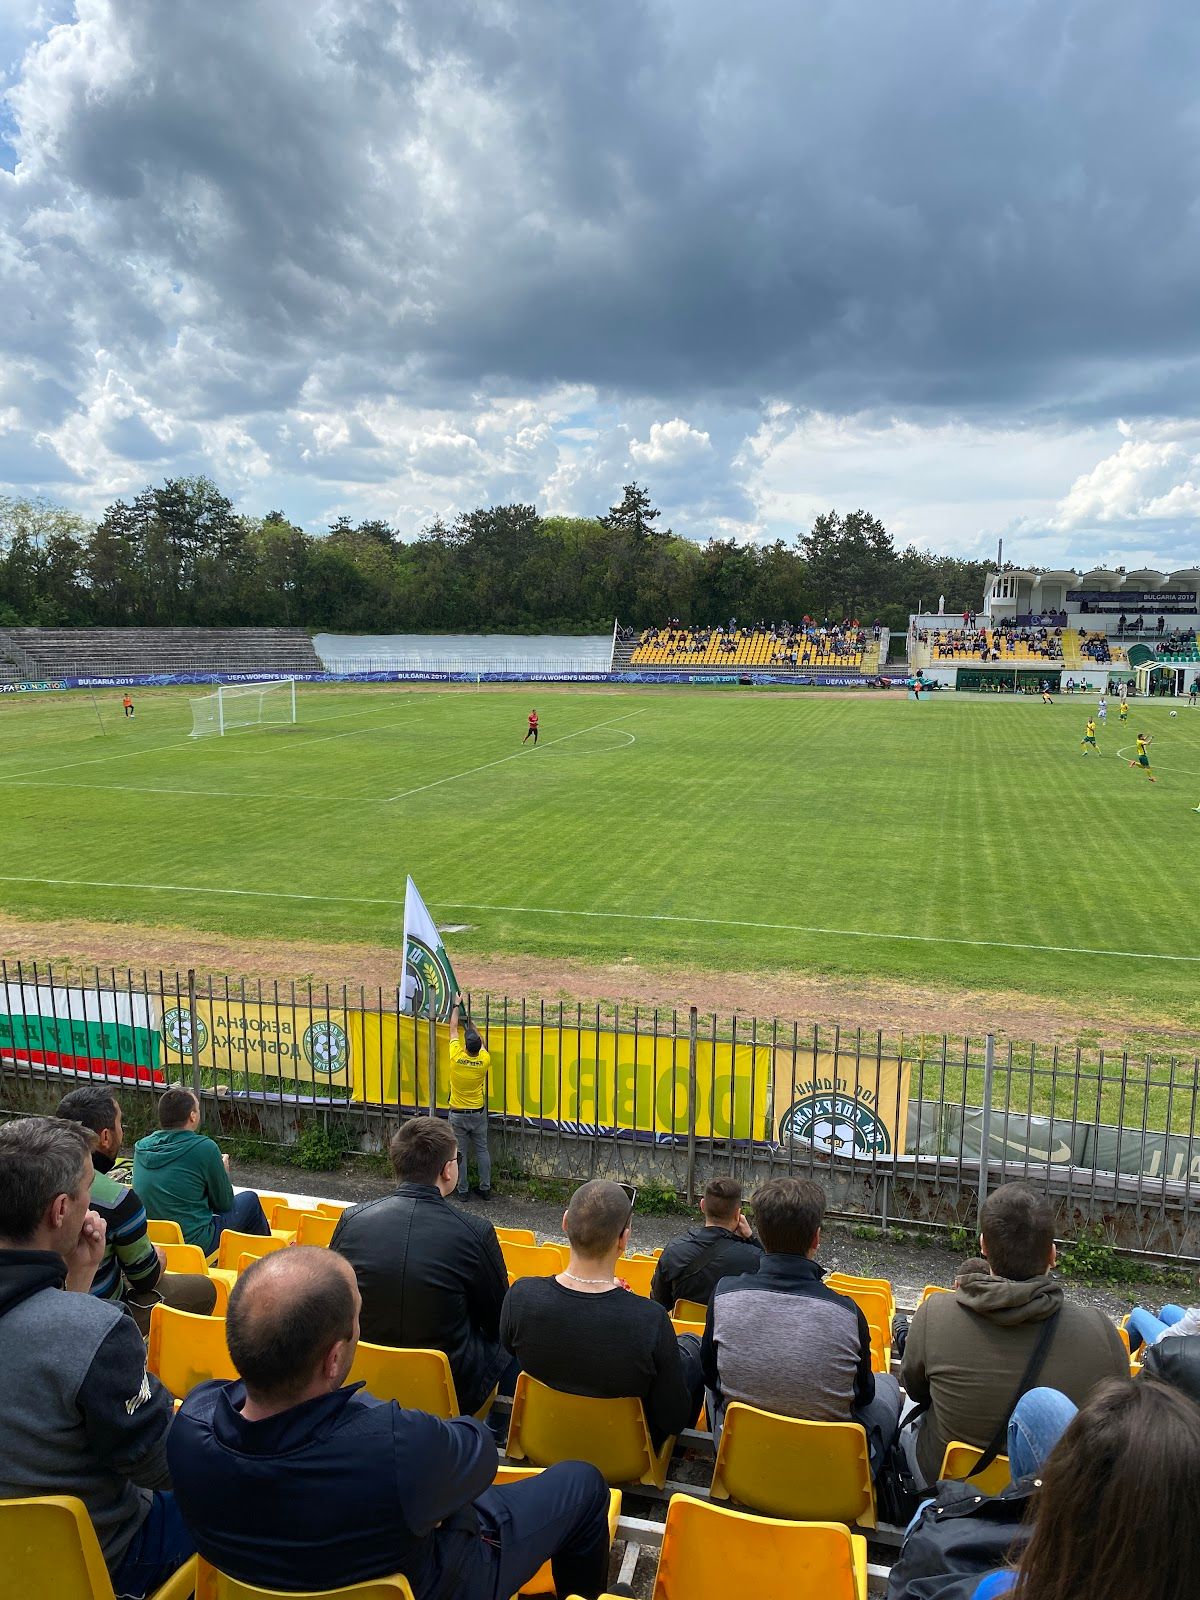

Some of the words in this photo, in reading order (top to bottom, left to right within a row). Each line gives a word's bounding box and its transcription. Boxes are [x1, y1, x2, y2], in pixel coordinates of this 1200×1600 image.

[1143, 593, 1177, 601] BULGARIA
[1178, 593, 1195, 601] 2019
[227, 673, 246, 681] UEFA
[280, 673, 312, 681] UNDER-17
[78, 677, 115, 686] BULGARIA
[116, 677, 134, 685] 2019
[15, 682, 66, 692] FOUNDATION
